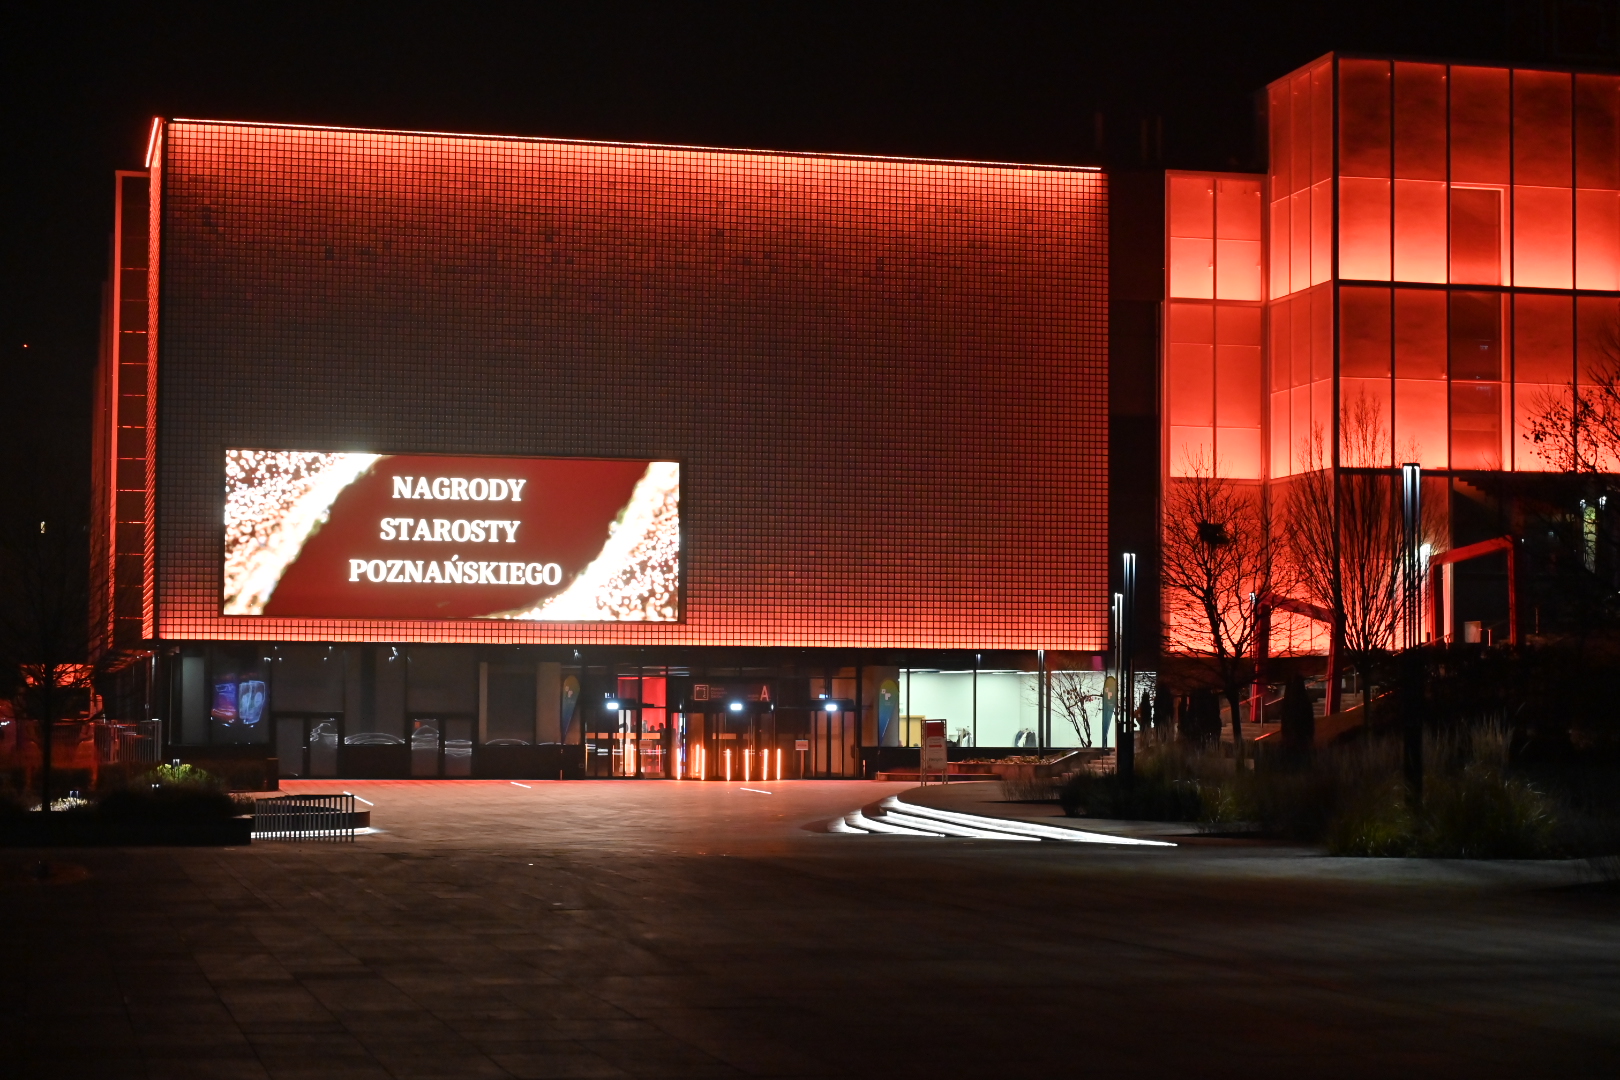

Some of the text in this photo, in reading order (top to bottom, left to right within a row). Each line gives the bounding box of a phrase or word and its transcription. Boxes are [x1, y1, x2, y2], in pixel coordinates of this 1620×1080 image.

[392, 476, 527, 502] NAGRODY
[379, 517, 521, 543] STAROSTY
[348, 554, 563, 586] POZNAŃSKIEGO
[760, 685, 770, 702] A
